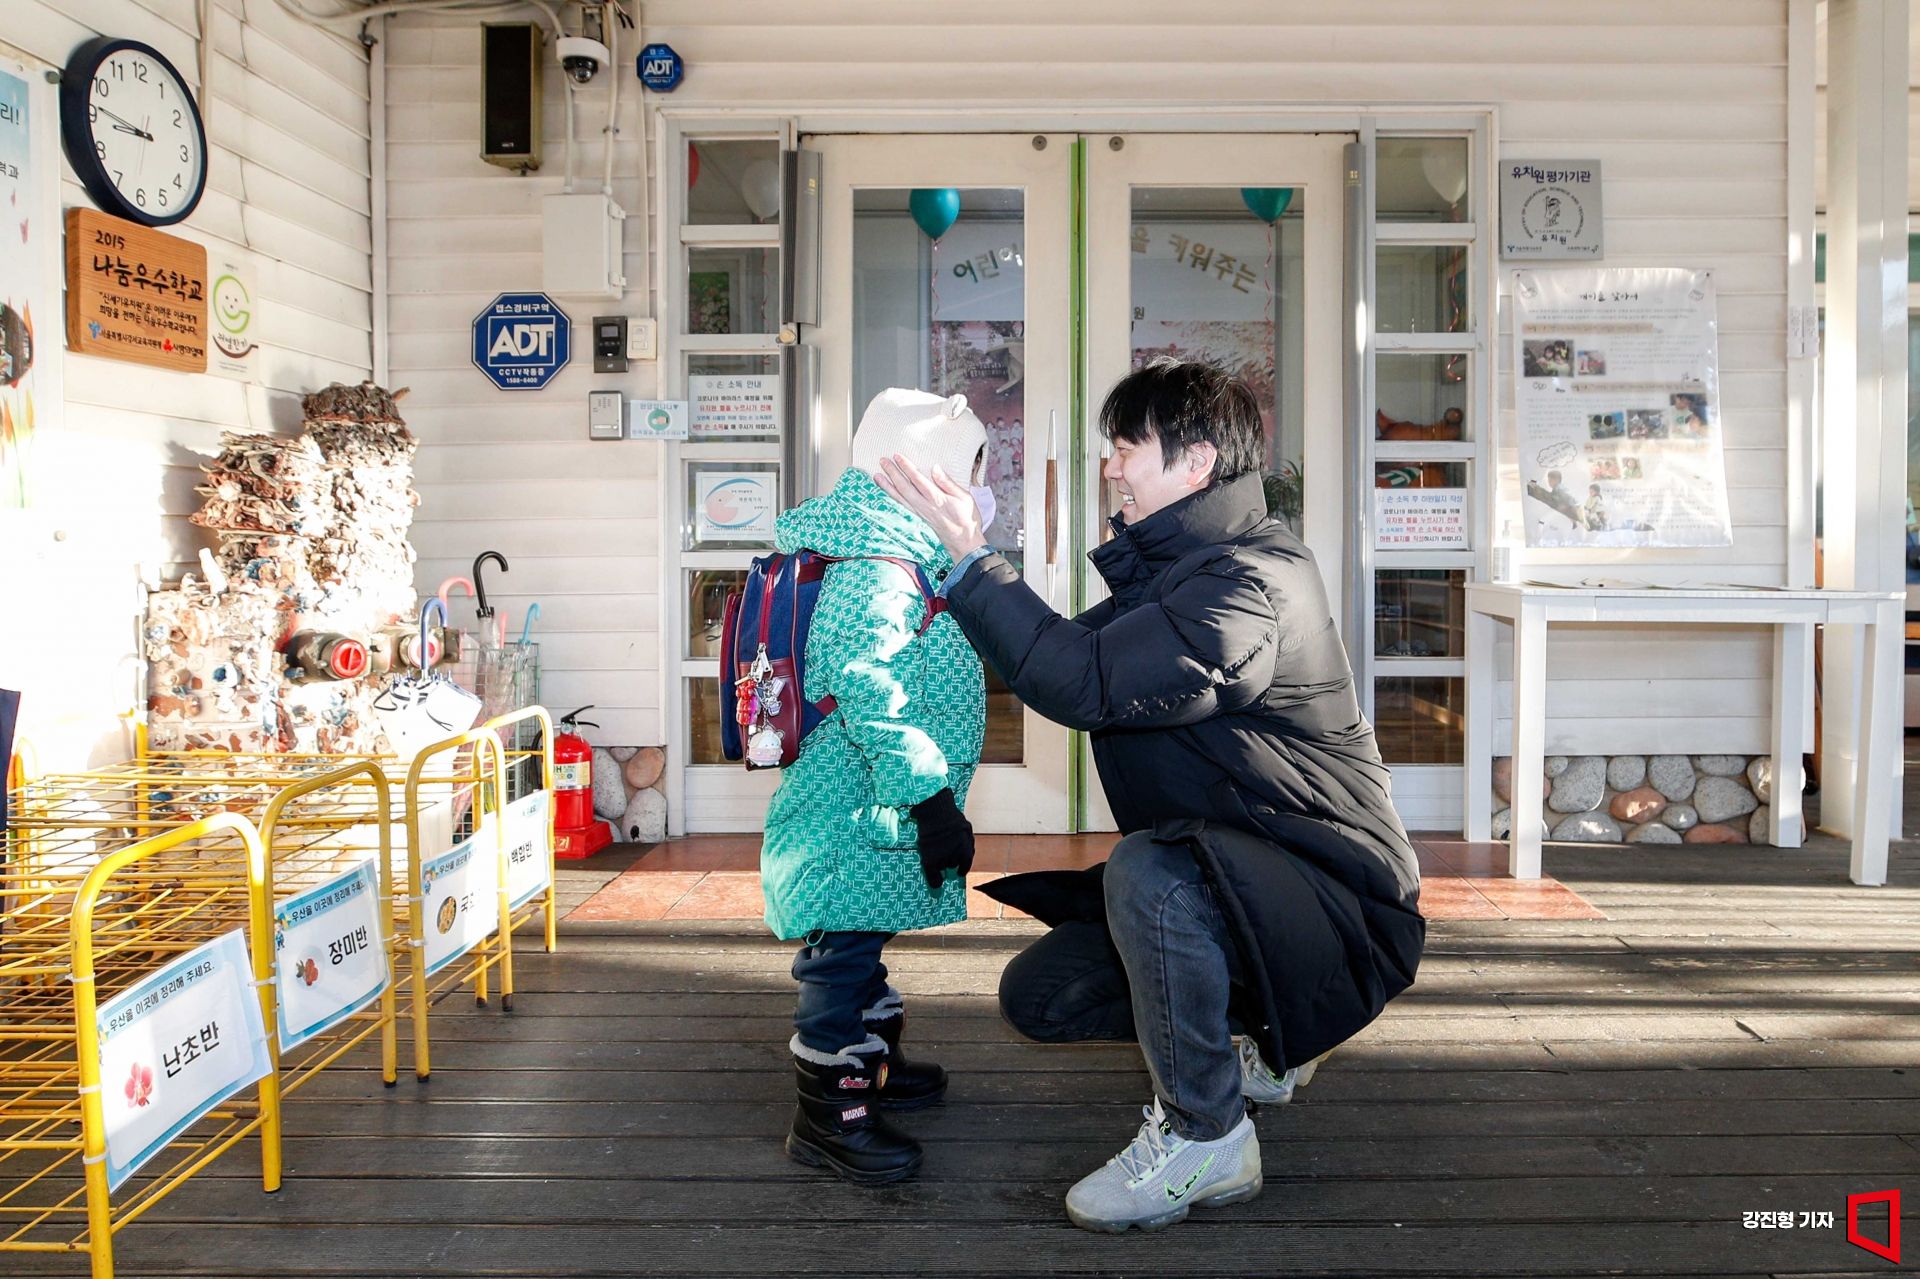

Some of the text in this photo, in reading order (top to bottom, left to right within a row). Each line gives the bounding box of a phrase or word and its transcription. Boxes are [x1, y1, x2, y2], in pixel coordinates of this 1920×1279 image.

[111, 60, 124, 81] 11
[132, 61, 148, 83] 12
[643, 59, 673, 75] ADT
[93, 77, 109, 98] 10
[158, 82, 165, 100] 1
[89, 104, 98, 123] 9
[172, 109, 183, 129] 2
[95, 140, 106, 161] 8
[180, 144, 189, 164] 3
[113, 170, 124, 190] 7
[172, 172, 183, 191] 4
[1512, 166, 1591, 184] 유치원 평가기관
[136, 188, 147, 207] 6
[158, 189, 168, 207] 5
[95, 229, 125, 250] 2015
[1168, 233, 1256, 294] 키워주는
[93, 254, 203, 302] 나눔우수학교
[489, 324, 554, 357] ADT
[511, 840, 532, 865] 백합반
[292, 905, 312, 922] 우산을
[314, 895, 333, 911] 이곳에
[334, 886, 351, 902] 정리해
[328, 925, 368, 965] 장미반
[109, 961, 215, 1032] 우산을 이곳에 정리해 주세요.
[163, 1020, 220, 1079] 난초반
[842, 1105, 867, 1121] MARVEL
